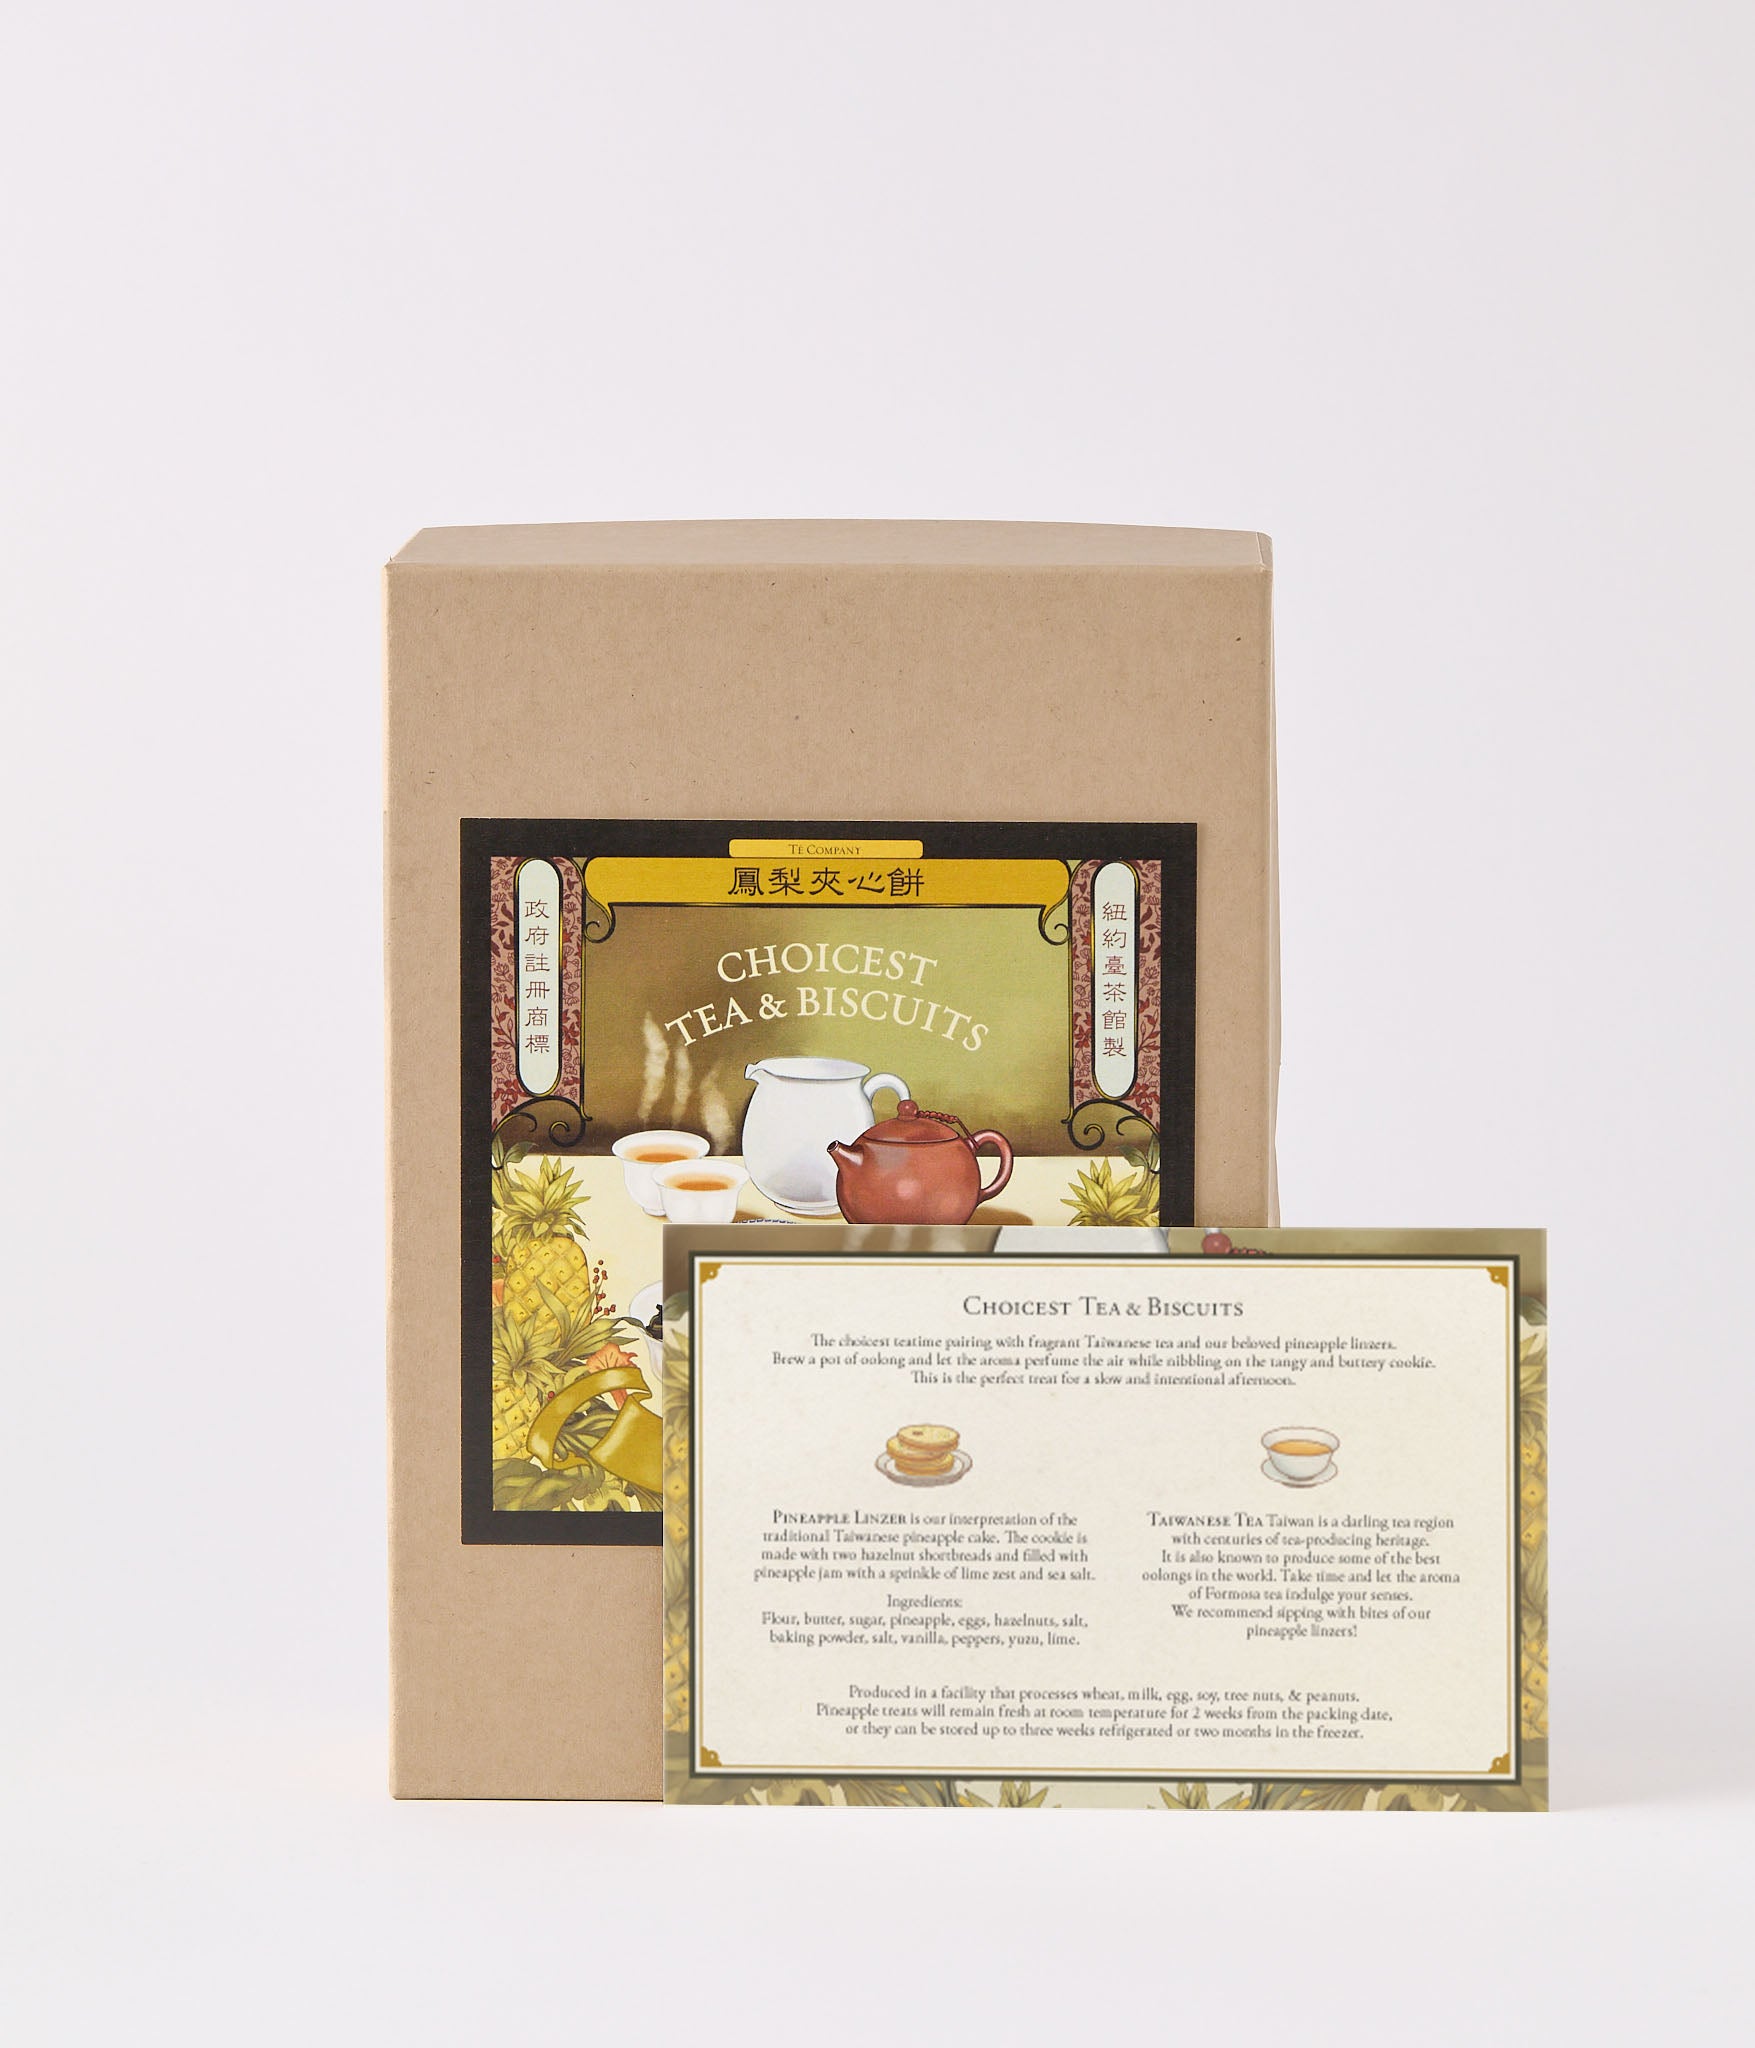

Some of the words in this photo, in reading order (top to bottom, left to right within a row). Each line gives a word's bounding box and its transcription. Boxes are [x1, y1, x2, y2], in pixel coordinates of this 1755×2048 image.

[728, 867, 925, 897] 鳳梨夾心餅
[717, 942, 938, 986] CHOICEST
[524, 899, 550, 1054] 政府註冊商標
[664, 996, 753, 1047] TEA
[758, 993, 788, 1020] &
[796, 986, 990, 1051] BISCUITS
[1125, 1303, 1142, 1317] &
[810, 1334, 837, 1347] The
[838, 1334, 890, 1348] choicest
[893, 1334, 943, 1348] teatime
[944, 1335, 994, 1352] pairing
[995, 1335, 1025, 1348] with
[1028, 1335, 1081, 1353] fragrant
[1083, 1336, 1153, 1349] Taiwanese
[1155, 1338, 1174, 1349] tea
[1176, 1336, 1201, 1349] and
[1204, 1341, 1228, 1350] our
[1231, 1336, 1281, 1350] beloved
[1284, 1337, 1349, 1354] pineapple
[910, 1371, 939, 1384] This
[942, 1371, 953, 1384] is
[955, 1371, 977, 1384] the
[979, 1371, 1025, 1389] perfect
[1028, 1374, 1058, 1385] treat
[1061, 1372, 1081, 1385] for
[1082, 1376, 1091, 1385] a
[1094, 1372, 1123, 1385] slow
[1124, 1372, 1152, 1385] and
[1153, 1372, 1226, 1386] intentional
[1227, 1373, 1297, 1386] afternoon.
[909, 1511, 921, 1524] is
[922, 1516, 947, 1525] our
[948, 1511, 1038, 1529] interpretation
[1039, 1512, 1056, 1525] of
[1057, 1512, 1078, 1525] the
[1265, 1513, 1315, 1527] Taiwan
[1317, 1514, 1329, 1527] is
[1330, 1518, 1339, 1527] a
[1340, 1514, 1390, 1531] darling
[1391, 1517, 1411, 1528] tea
[1413, 1514, 1455, 1532] region
[762, 1528, 830, 1542] traditional
[832, 1529, 900, 1542] Taiwanese
[902, 1529, 965, 1547] pineapple
[1003, 1530, 1029, 1543] The
[1030, 1530, 1074, 1543] cookie
[1076, 1530, 1089, 1543] is
[1170, 1531, 1202, 1544] with
[1203, 1531, 1263, 1545] centuries
[1264, 1531, 1281, 1545] of
[1281, 1532, 1373, 1549] tea-producing
[1161, 1549, 1172, 1563] It
[1174, 1549, 1187, 1563] is
[1188, 1549, 1215, 1563] also
[1217, 1550, 1263, 1563] known
[1265, 1552, 1280, 1563] to
[1282, 1550, 1336, 1568] produce
[1338, 1555, 1372, 1564] some
[1373, 1550, 1390, 1564] of
[1390, 1551, 1411, 1564] the
[1414, 1551, 1441, 1564] best
[1187, 1586, 1204, 1599] of
[1205, 1586, 1261, 1600] Formosa
[1263, 1589, 1283, 1600] tea
[1285, 1587, 1335, 1604] indulge
[1337, 1591, 1368, 1604] your
[1170, 1604, 1194, 1617] We
[1196, 1604, 1274, 1618] recommend
[1276, 1605, 1325, 1622] sipping
[1326, 1605, 1356, 1618] with
[1359, 1605, 1389, 1618] bites
[1391, 1605, 1406, 1619] of
[1408, 1610, 1432, 1619] our
[769, 1630, 815, 1647] baking
[1246, 1623, 1308, 1640] pineapple
[848, 1685, 911, 1699] Produced
[914, 1685, 928, 1699] in
[930, 1690, 938, 1699] a
[989, 1686, 1016, 1699] that
[1018, 1691, 1079, 1704] processes
[1223, 1690, 1250, 1701] tree
[1287, 1687, 1303, 1701] &
[816, 1703, 880, 1720] Pineapple
[881, 1706, 919, 1717] treats
[920, 1703, 946, 1717] will
[949, 1704, 995, 1717] remain
[998, 1704, 1031, 1717] fresh
[1033, 1706, 1047, 1717] at
[1049, 1709, 1085, 1718] room
[1088, 1707, 1168, 1722] temperature
[1170, 1705, 1189, 1718] for
[1191, 1705, 1201, 1718] 2
[1203, 1705, 1244, 1719] weeks
[1246, 1705, 1278, 1719] from
[1281, 1705, 1304, 1719] the
[1306, 1706, 1359, 1723] packing
[845, 1726, 860, 1735] or
[862, 1722, 893, 1739] they
[893, 1726, 918, 1735] can
[920, 1722, 937, 1735] be
[939, 1722, 979, 1735] stored
[982, 1727, 1001, 1740] up
[1002, 1725, 1017, 1736] to
[1019, 1722, 1054, 1736] three
[1056, 1723, 1096, 1736] weeks
[1098, 1723, 1173, 1741] refrigerated
[1175, 1728, 1191, 1737] or
[1193, 1726, 1220, 1737] two
[1222, 1724, 1272, 1737] months
[1275, 1724, 1290, 1737] in
[1291, 1724, 1315, 1737] the
